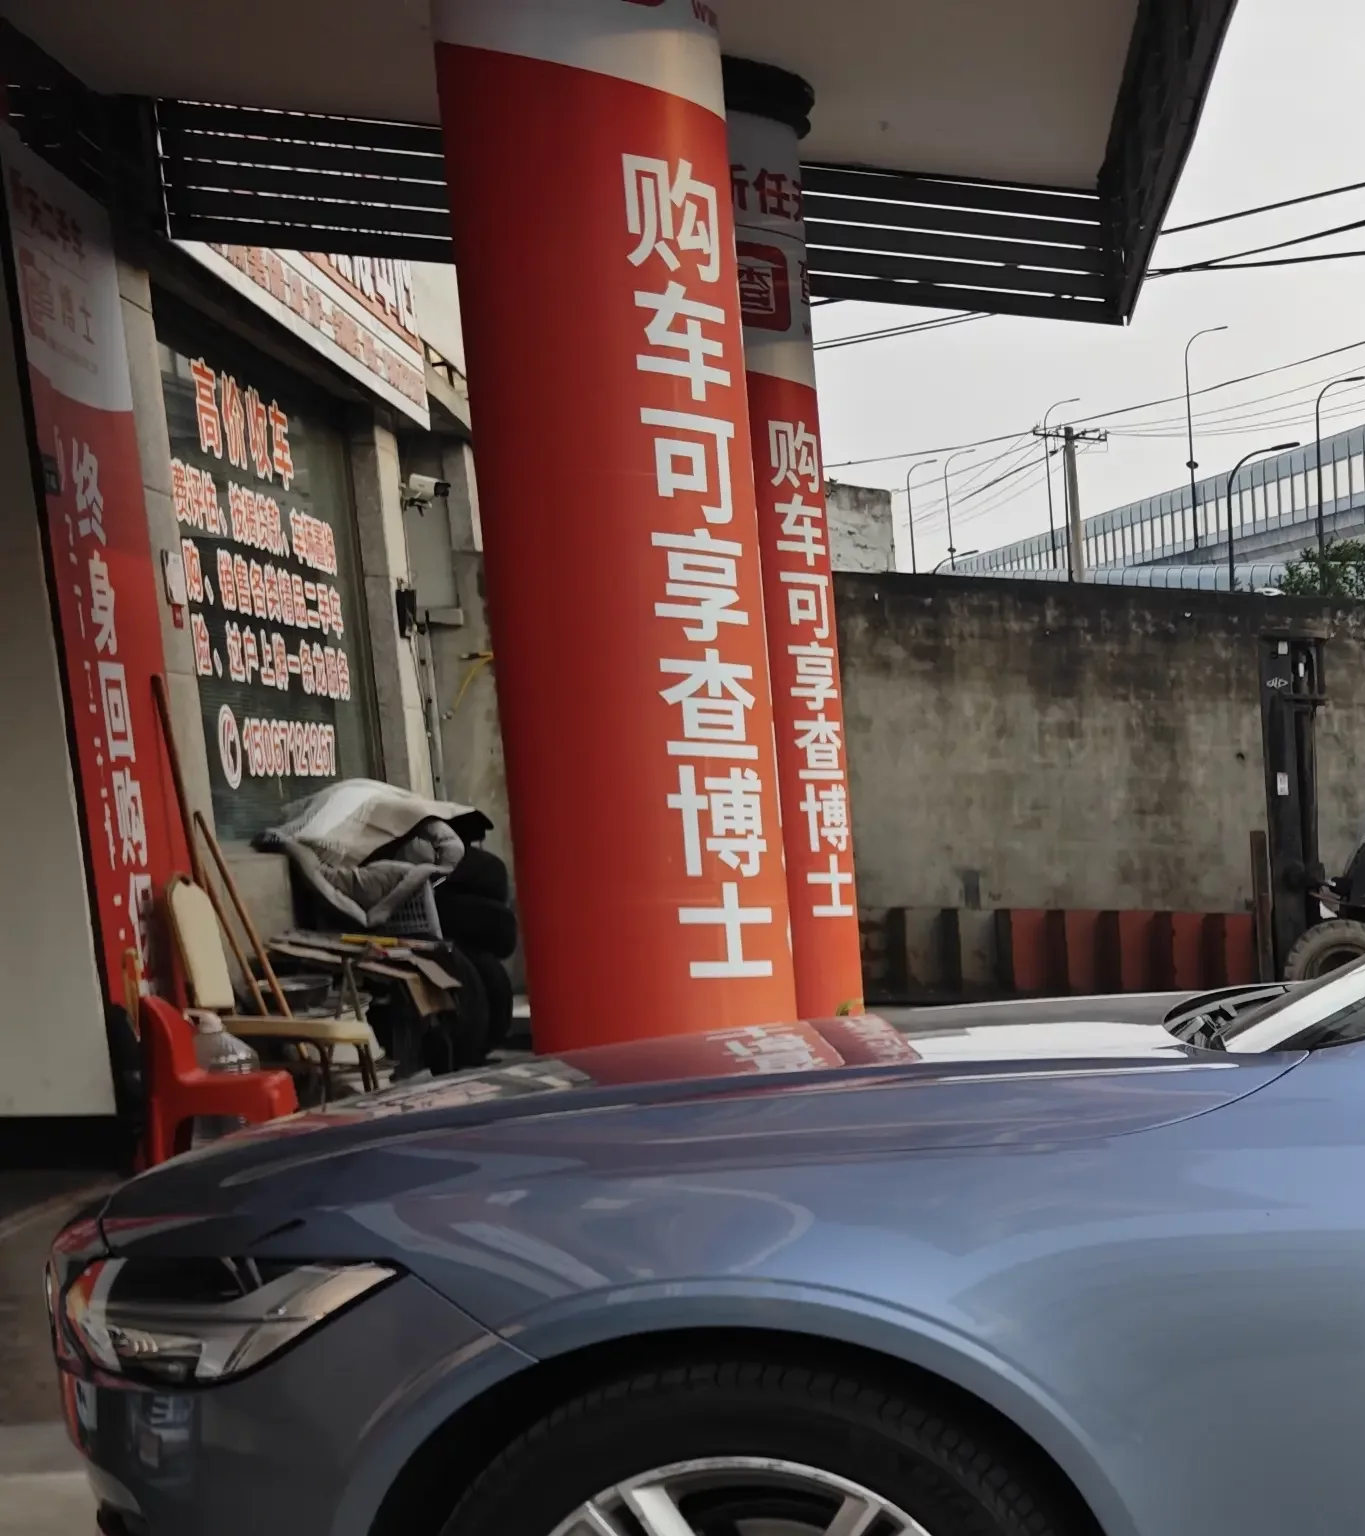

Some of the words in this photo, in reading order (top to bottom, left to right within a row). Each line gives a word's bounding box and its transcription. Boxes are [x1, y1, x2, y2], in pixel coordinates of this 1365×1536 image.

[191, 357, 294, 491] 高价收车
[621, 153, 773, 978] 购车可享查博士
[768, 420, 854, 917] 购车可享查博士
